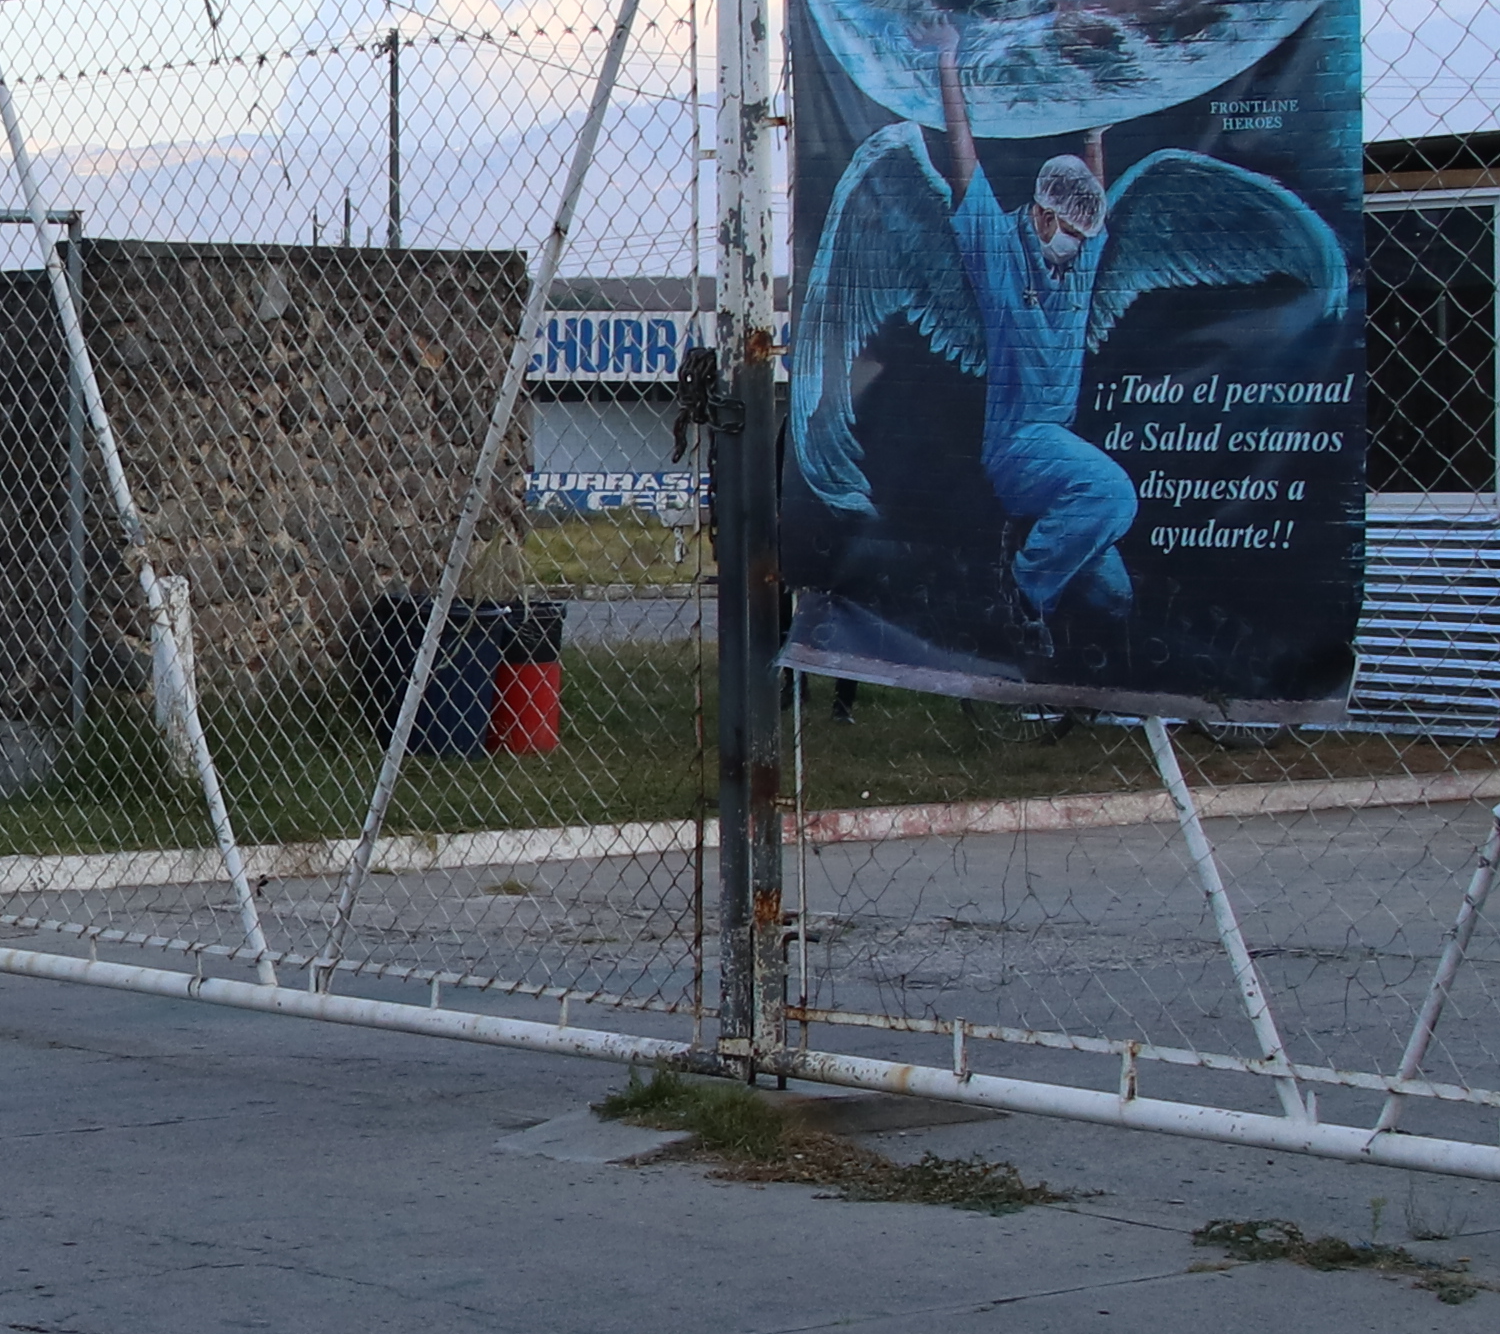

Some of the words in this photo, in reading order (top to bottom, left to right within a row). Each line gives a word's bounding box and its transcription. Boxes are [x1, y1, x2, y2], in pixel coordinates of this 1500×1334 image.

[1211, 100, 1299, 114] FRONTLINE
[1223, 116, 1282, 130] HEROES
[1095, 375, 1184, 411] ¡¡Todo
[1193, 375, 1219, 403] el
[1222, 373, 1354, 411] personal
[1105, 422, 1133, 450] de
[1141, 423, 1222, 451] Salud
[1229, 429, 1343, 451] estamos
[1140, 470, 1278, 507] dispuestos
[1288, 481, 1305, 500] a
[1151, 519, 1294, 554] ayudarte!!
